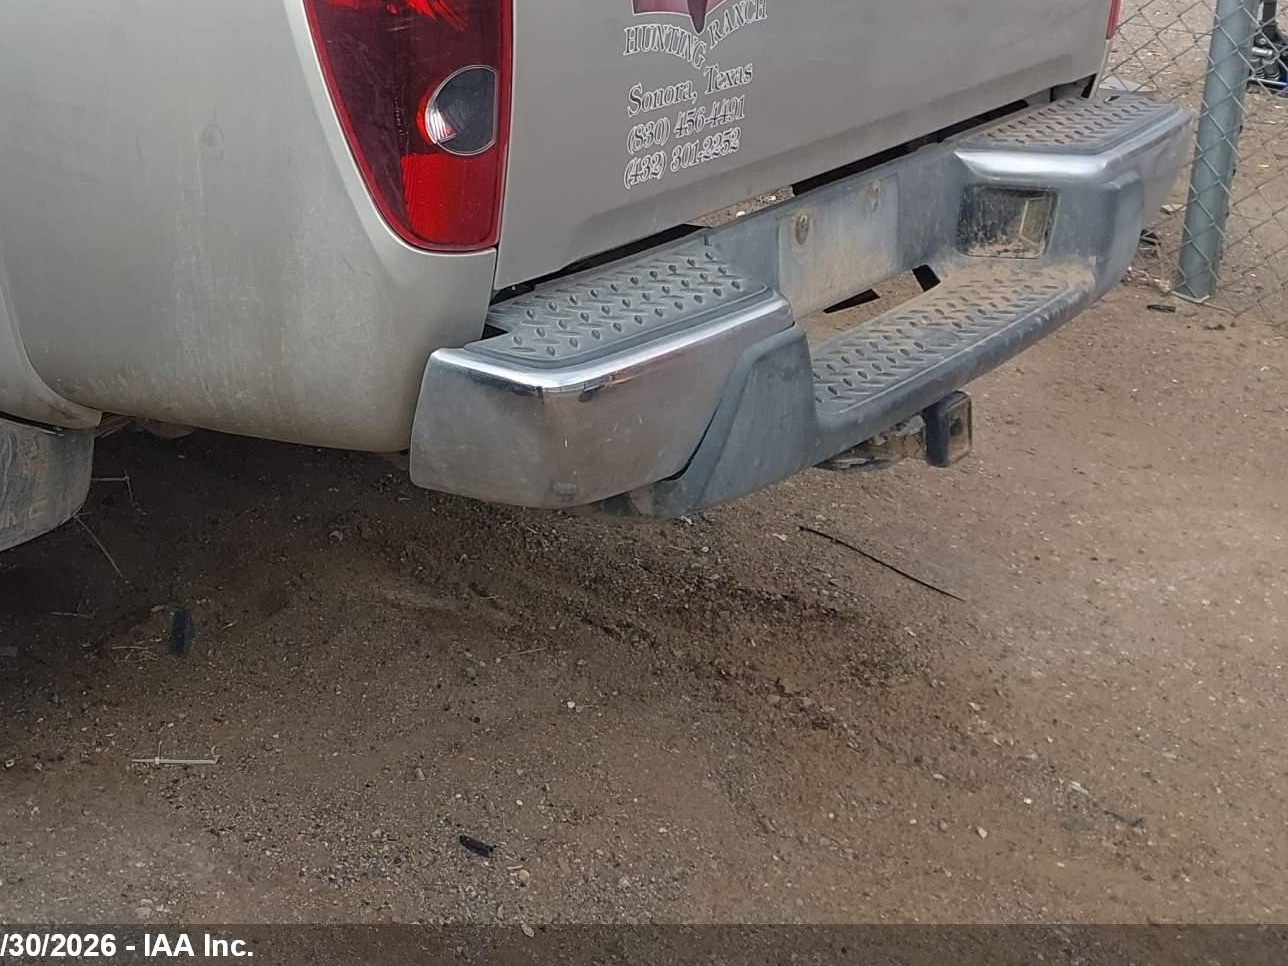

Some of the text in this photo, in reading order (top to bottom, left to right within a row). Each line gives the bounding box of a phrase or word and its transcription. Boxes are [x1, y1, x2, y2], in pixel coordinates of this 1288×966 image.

[623, 24, 707, 70] HUNTING
[627, 63, 753, 118] Sonora, Texas
[626, 95, 746, 155] (830) 456-4491
[623, 126, 742, 190] (432) 301-2252
